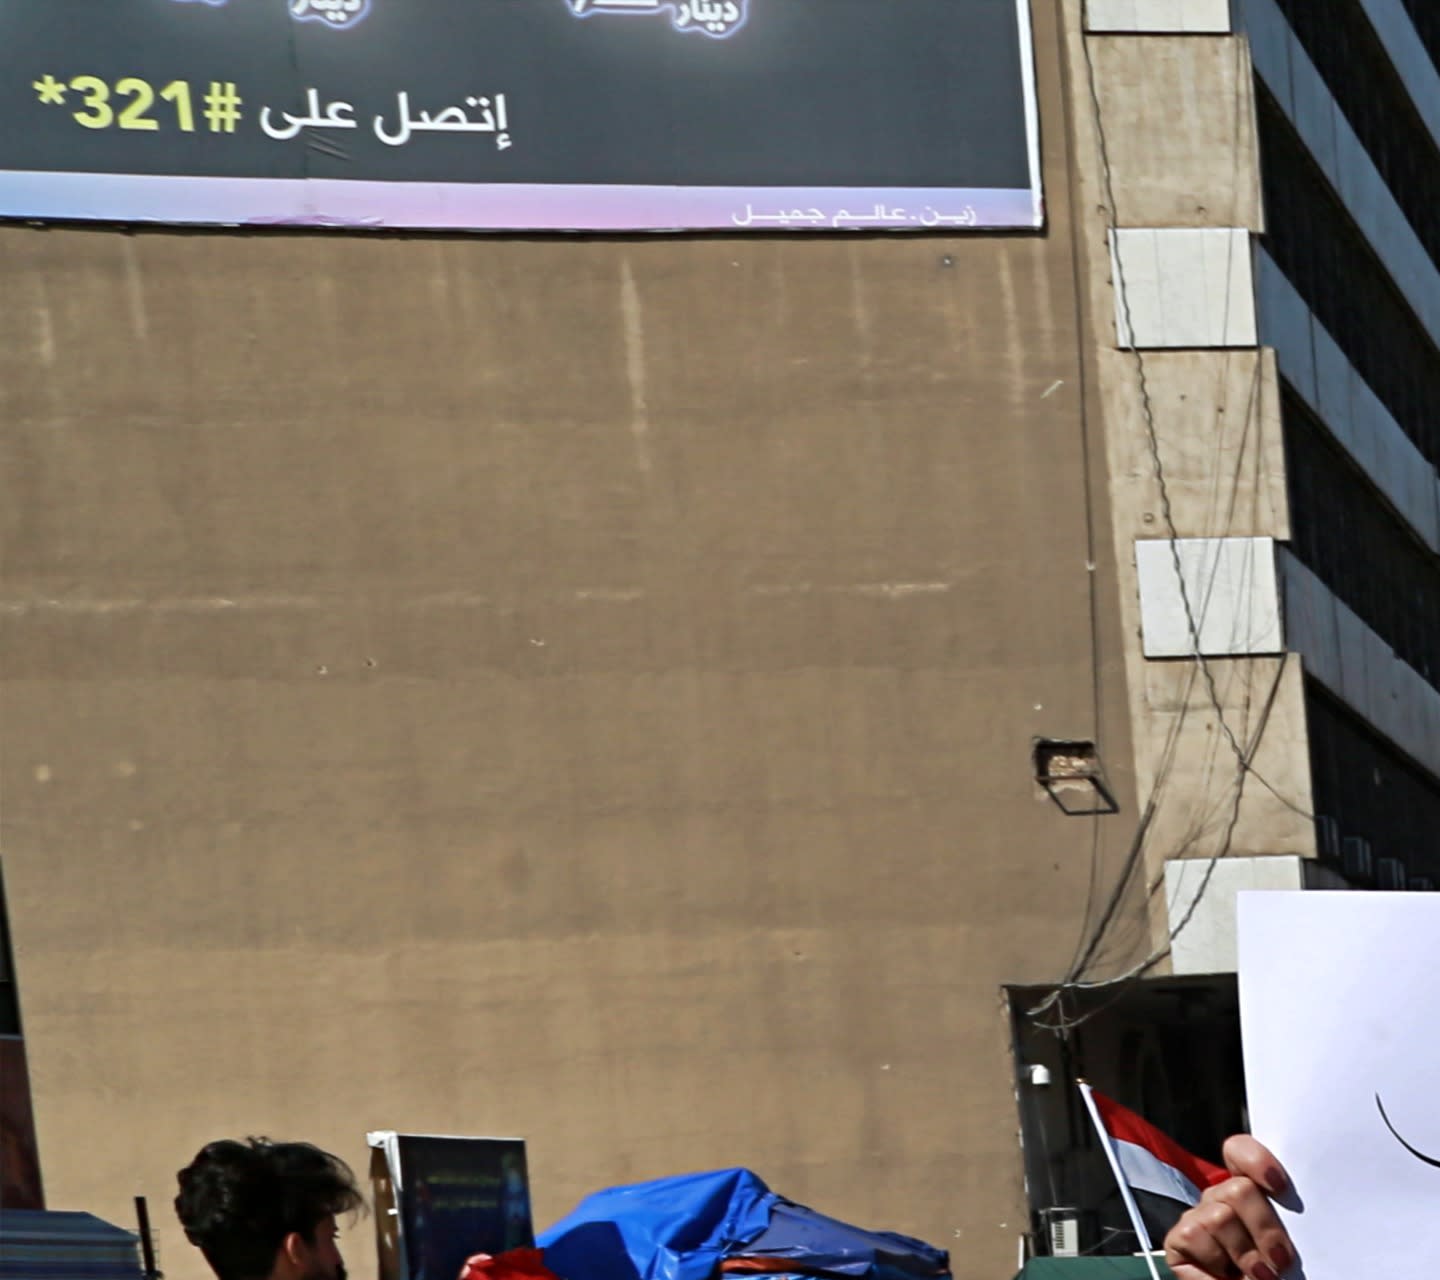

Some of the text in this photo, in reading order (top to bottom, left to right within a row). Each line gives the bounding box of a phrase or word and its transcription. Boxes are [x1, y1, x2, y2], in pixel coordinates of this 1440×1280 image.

[259, 86, 357, 142] على
[372, 90, 511, 151] إتصل
[732, 204, 826, 226] جميل
